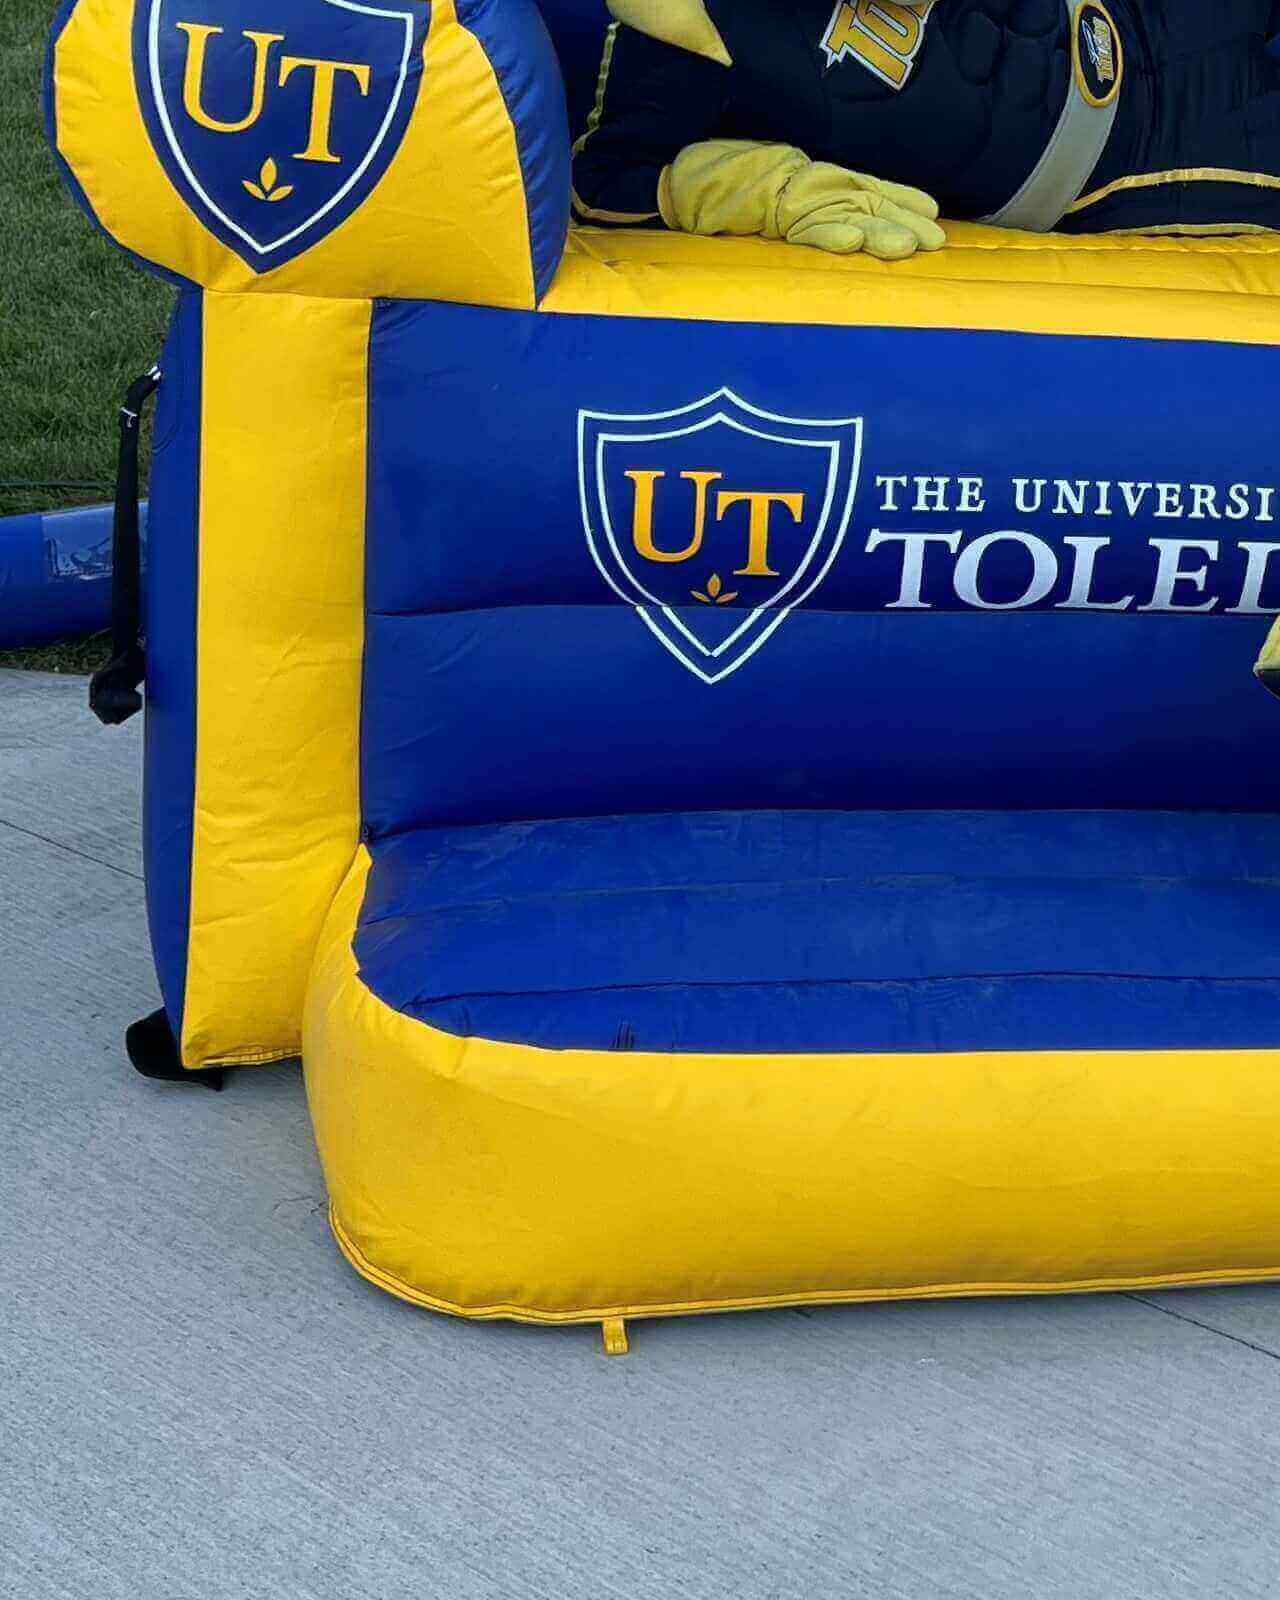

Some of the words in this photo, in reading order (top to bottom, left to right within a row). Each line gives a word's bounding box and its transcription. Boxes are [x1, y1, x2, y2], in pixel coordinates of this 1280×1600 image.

[176, 21, 371, 163] UT
[623, 469, 806, 576] UT
[875, 474, 987, 512] THE
